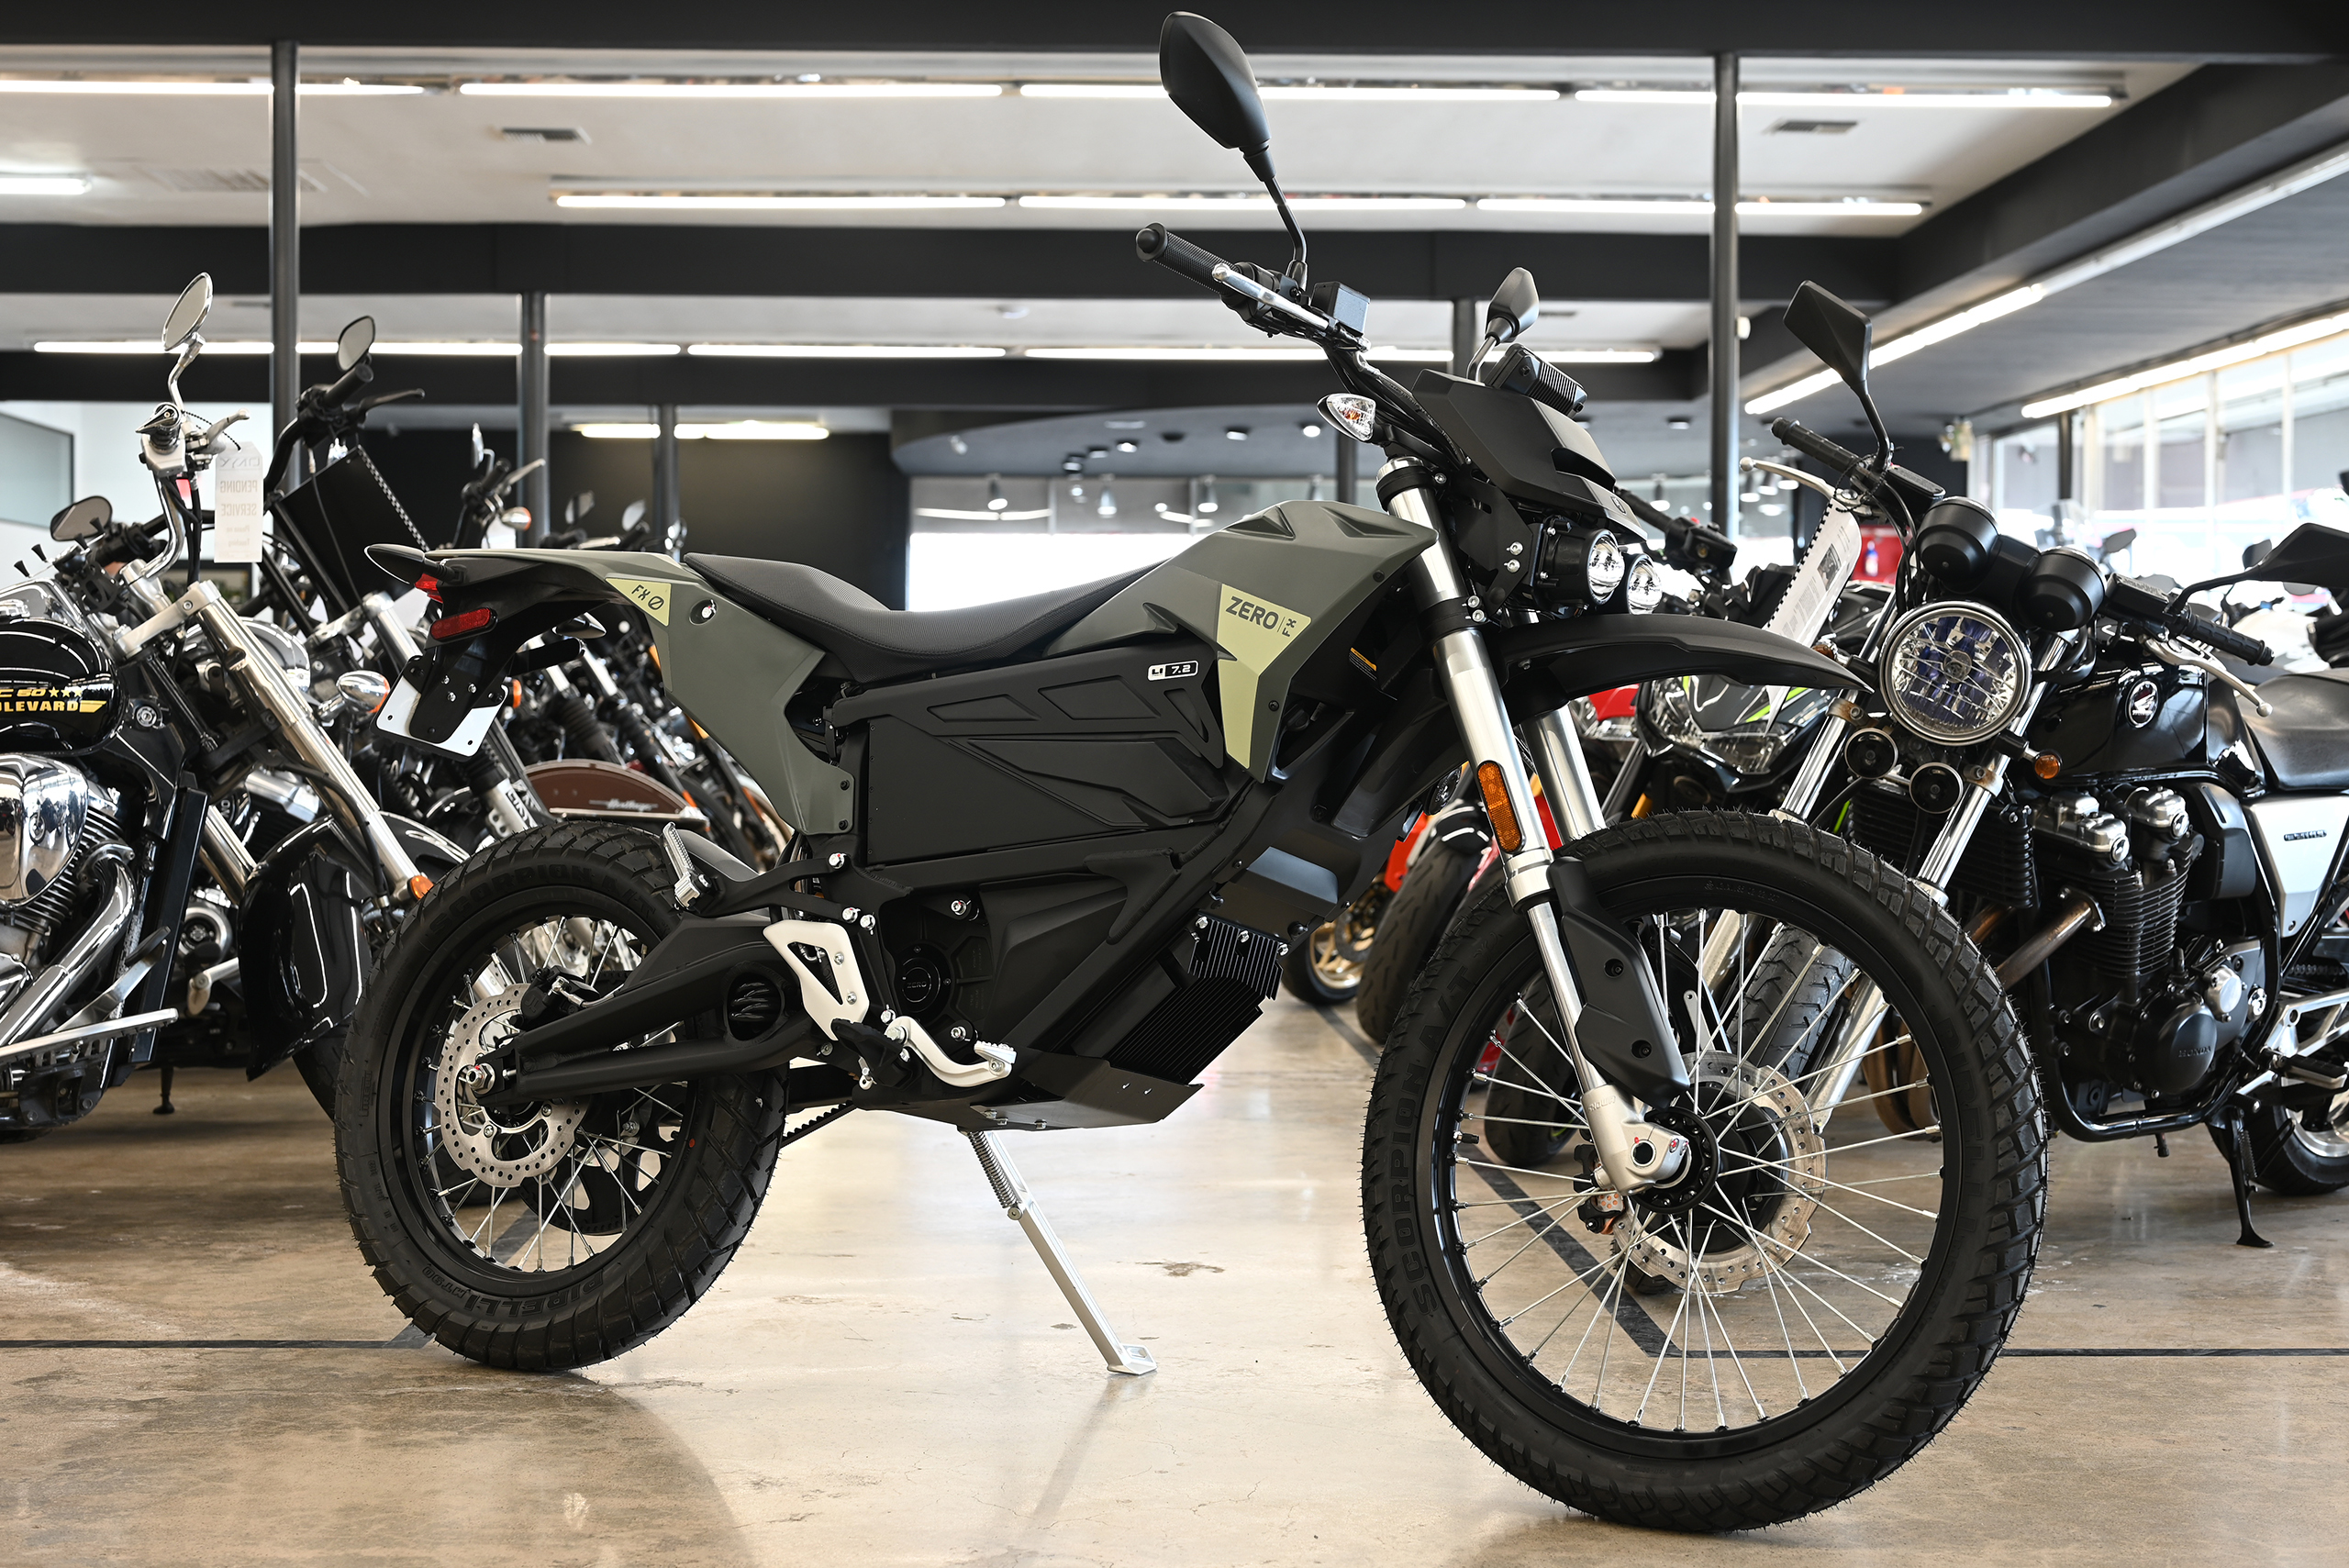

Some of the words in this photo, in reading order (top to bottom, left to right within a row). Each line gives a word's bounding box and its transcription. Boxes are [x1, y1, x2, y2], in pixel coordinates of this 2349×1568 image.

[1225, 595, 1279, 629] ZERO
[1171, 664, 1191, 674] 7.2
[429, 863, 593, 935] SCORPION
[907, 981, 927, 989] ZERO
[1388, 1062, 1439, 1315] SCORPION
[421, 1267, 469, 1299] MT90
[464, 1270, 602, 1317] PIRELLI
